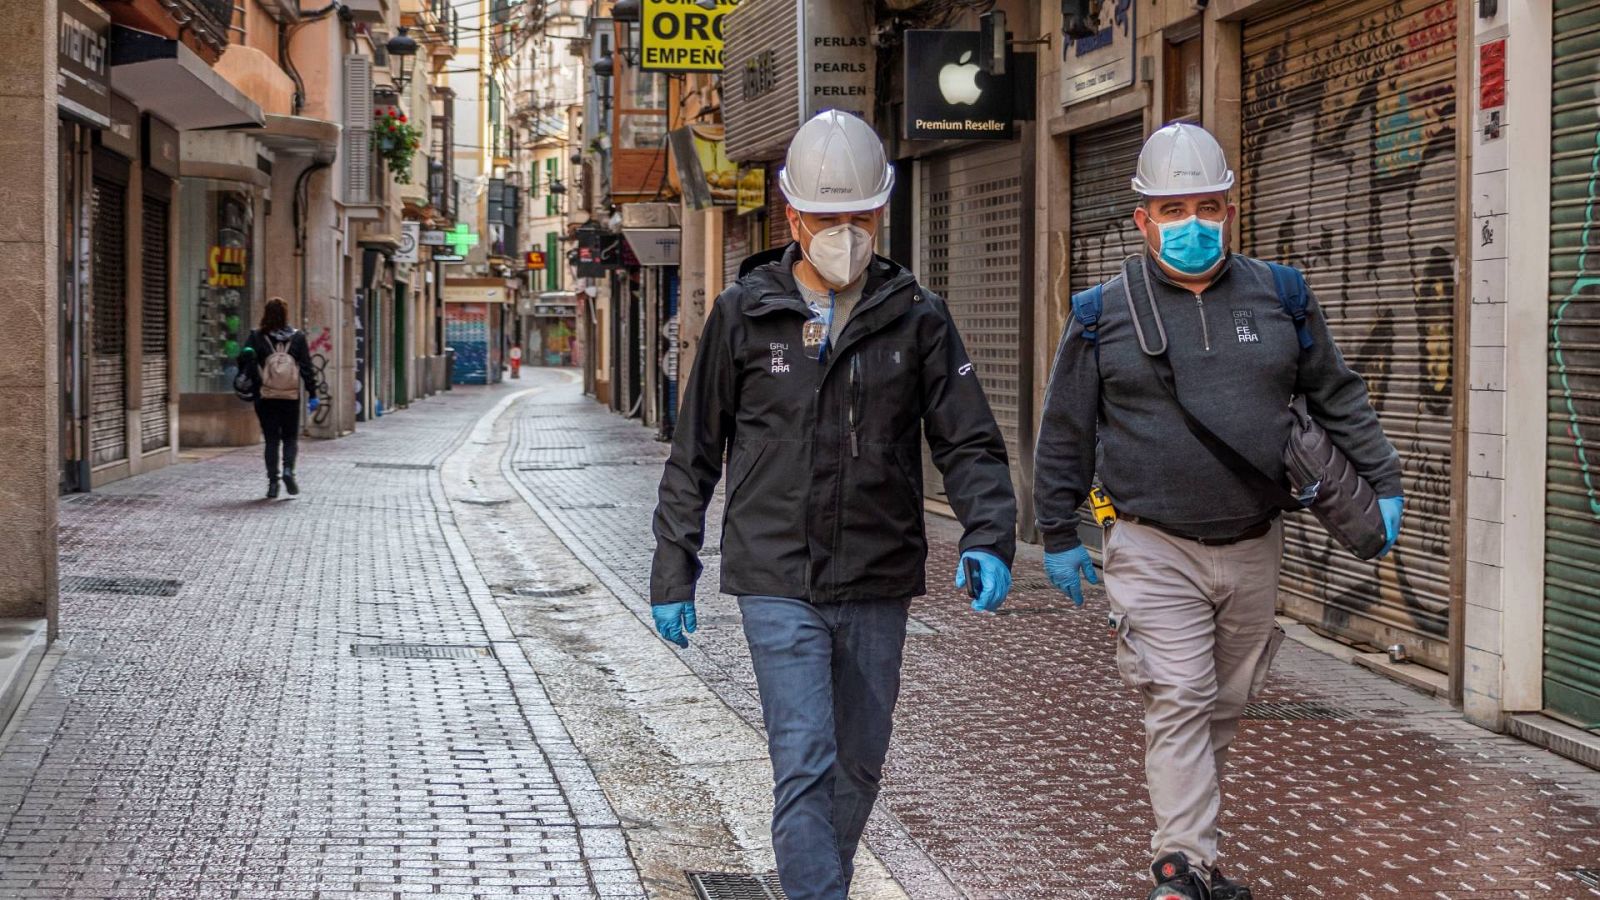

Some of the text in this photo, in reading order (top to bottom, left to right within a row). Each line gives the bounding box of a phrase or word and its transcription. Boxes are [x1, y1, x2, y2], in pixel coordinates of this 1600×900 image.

[814, 37, 866, 47] PERLAS
[814, 63, 866, 72] PEARLS
[814, 86, 866, 96] PERLEN
[915, 119, 1005, 131] Premium Reseller
[1236, 326, 1250, 334] FE
